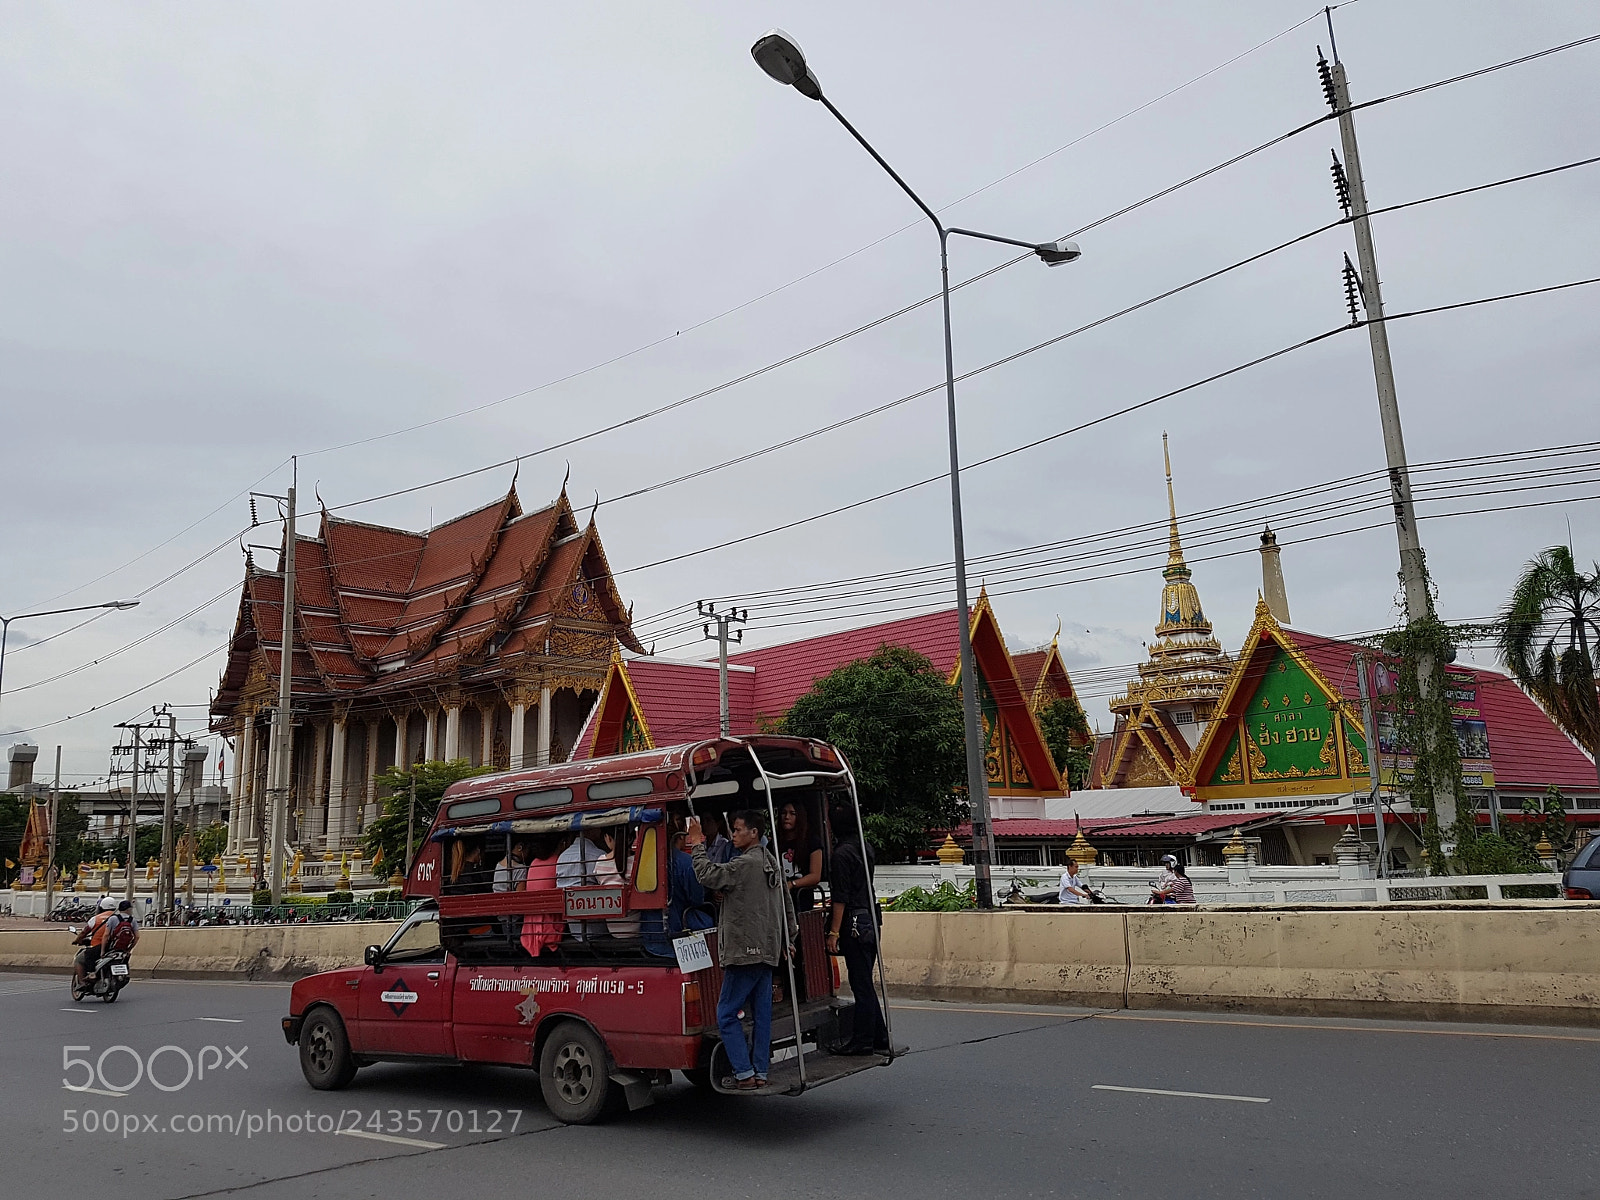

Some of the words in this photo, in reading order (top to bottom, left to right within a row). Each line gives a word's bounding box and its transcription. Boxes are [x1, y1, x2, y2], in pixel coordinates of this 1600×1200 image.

[1274, 712, 1303, 722] ศาลา
[566, 892, 622, 911] วัดนาวง
[636, 980, 645, 995] 5
